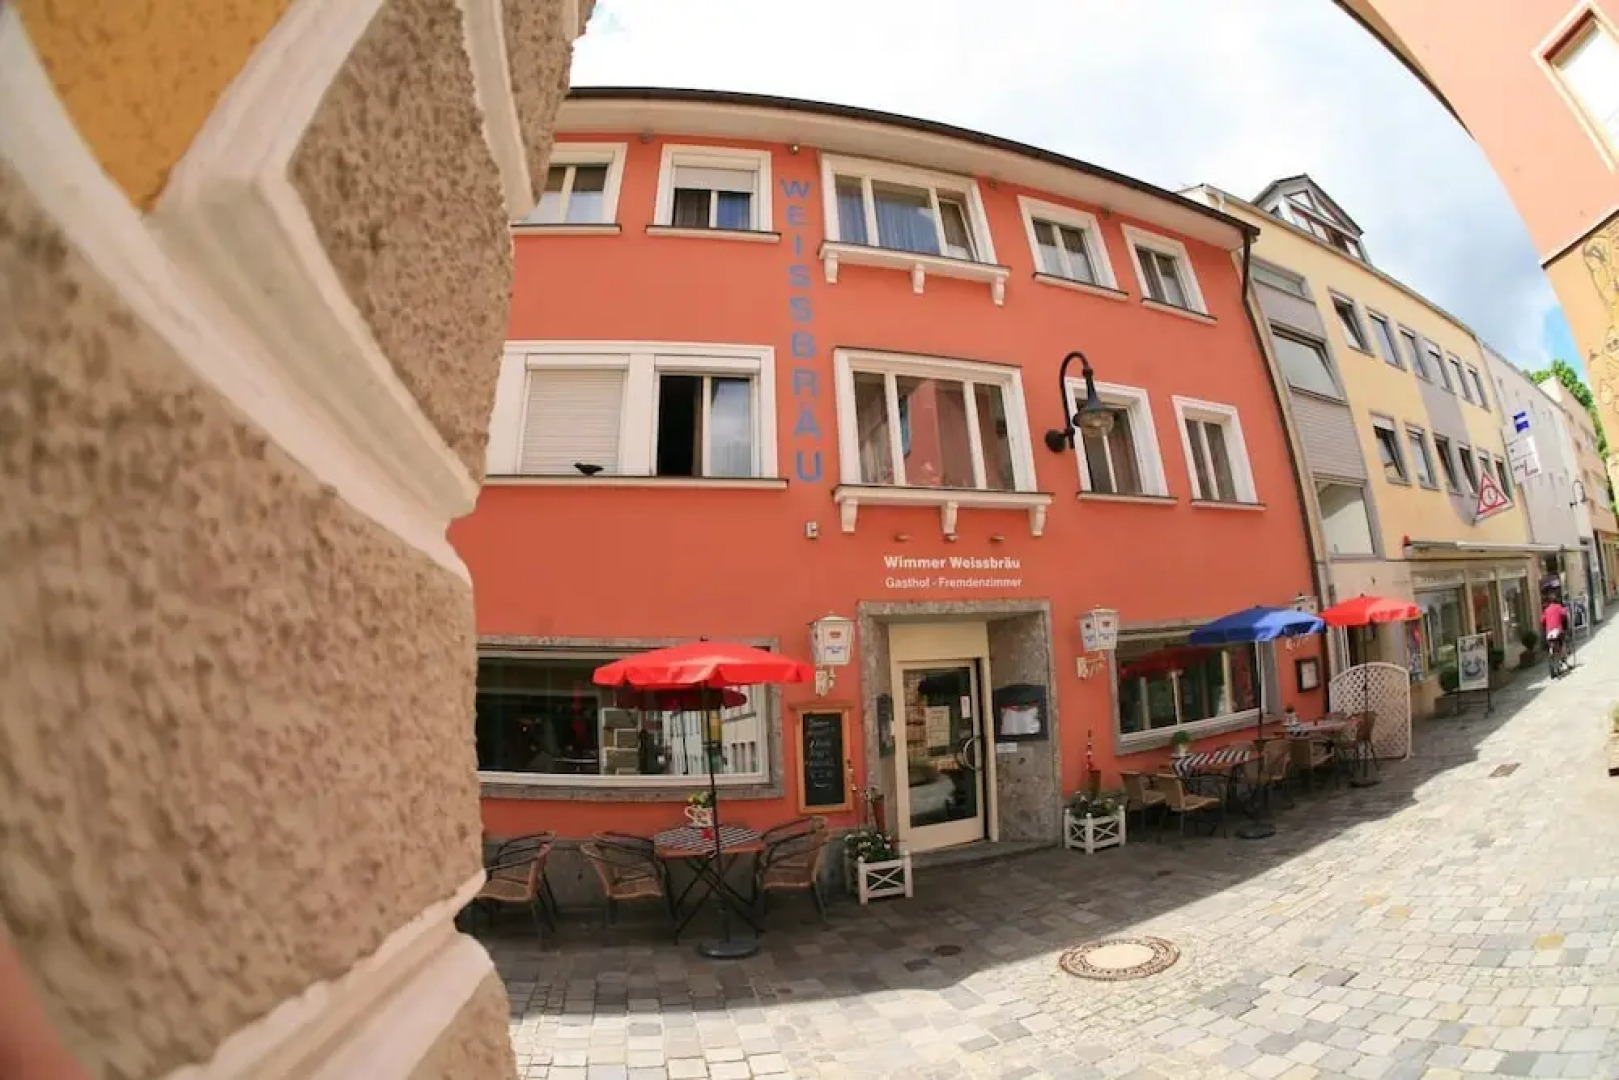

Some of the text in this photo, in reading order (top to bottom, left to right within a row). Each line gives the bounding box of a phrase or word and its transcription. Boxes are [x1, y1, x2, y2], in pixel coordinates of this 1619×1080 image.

[884, 556, 1021, 570] Wimmer Weissbräu
[885, 577, 930, 589] Gasthof
[938, 577, 1022, 588] Fremdenzimmer
